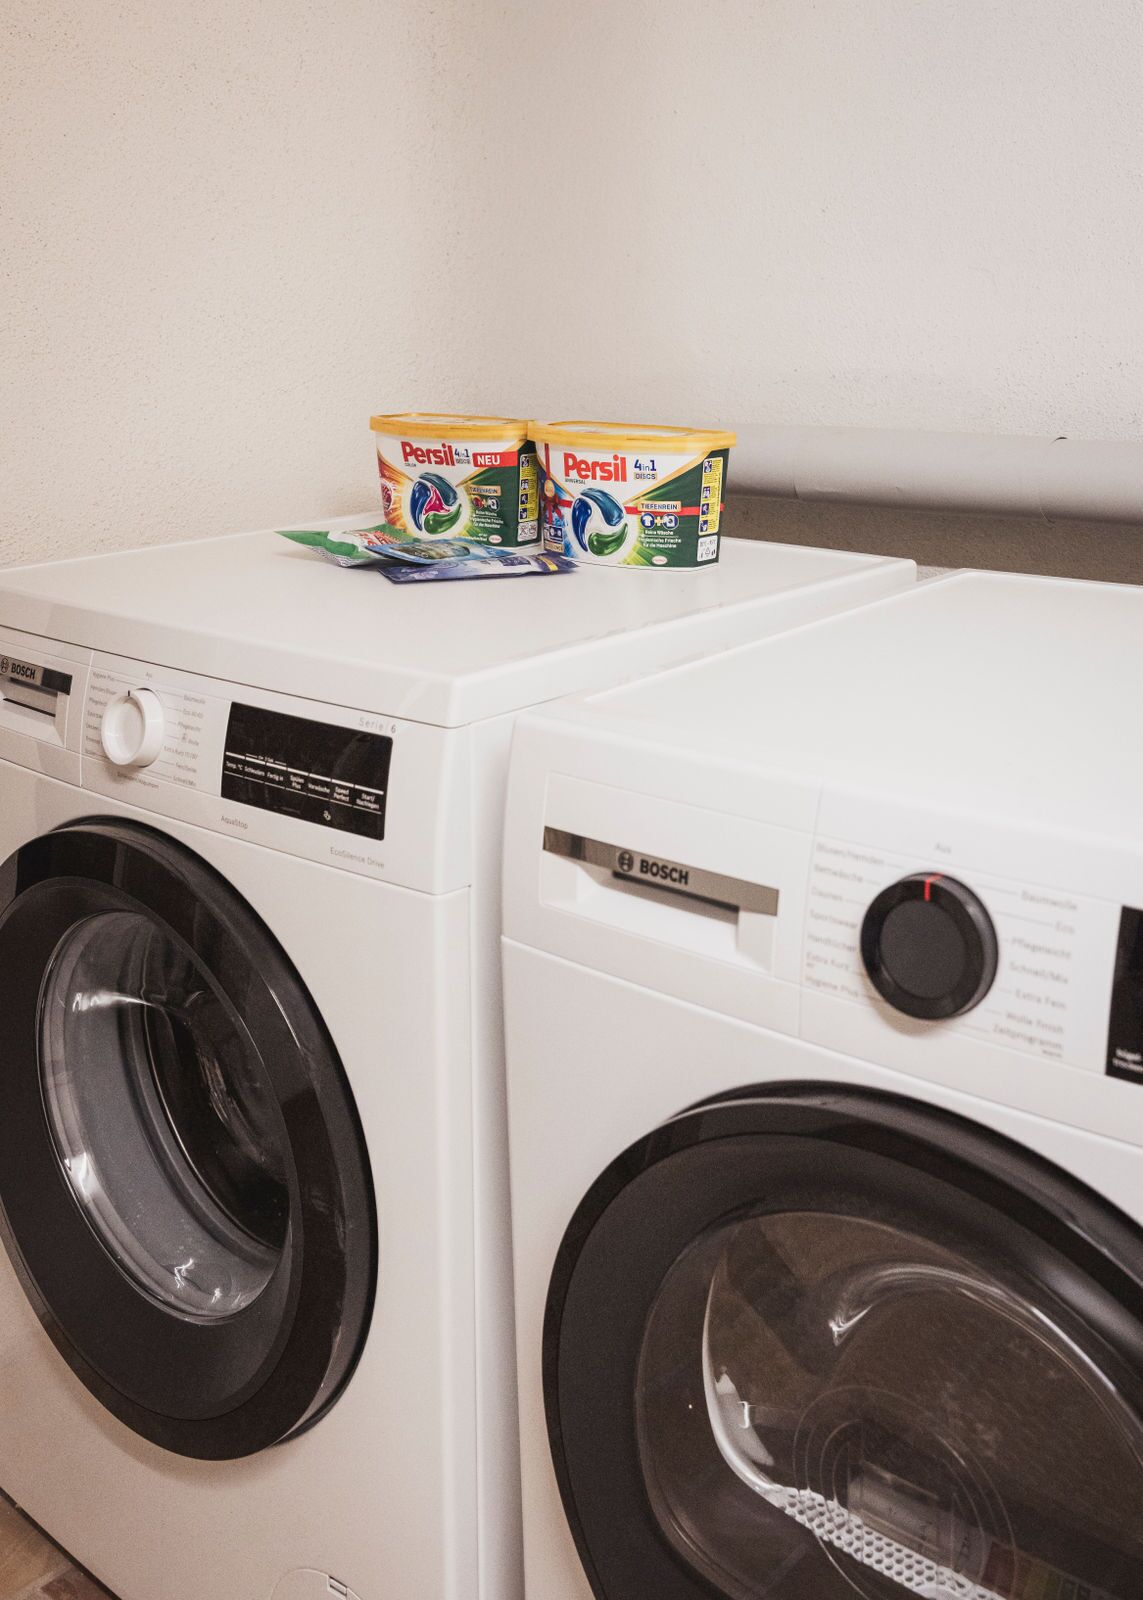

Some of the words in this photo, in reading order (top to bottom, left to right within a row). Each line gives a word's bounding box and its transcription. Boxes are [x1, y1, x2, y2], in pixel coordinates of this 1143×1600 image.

[401, 441, 456, 467] Persil
[477, 455, 500, 465] NEU
[563, 452, 627, 482] Persil
[634, 458, 657, 471] 4in1
[641, 502, 678, 510] TIEFENREIN
[11, 663, 36, 680] BOSCH
[359, 717, 385, 732] Serie
[390, 723, 397, 734] 6
[220, 814, 249, 831] AquaStop
[329, 846, 366, 864] EcoSilence
[367, 856, 385, 868] Drive
[639, 858, 690, 885] BOSCH
